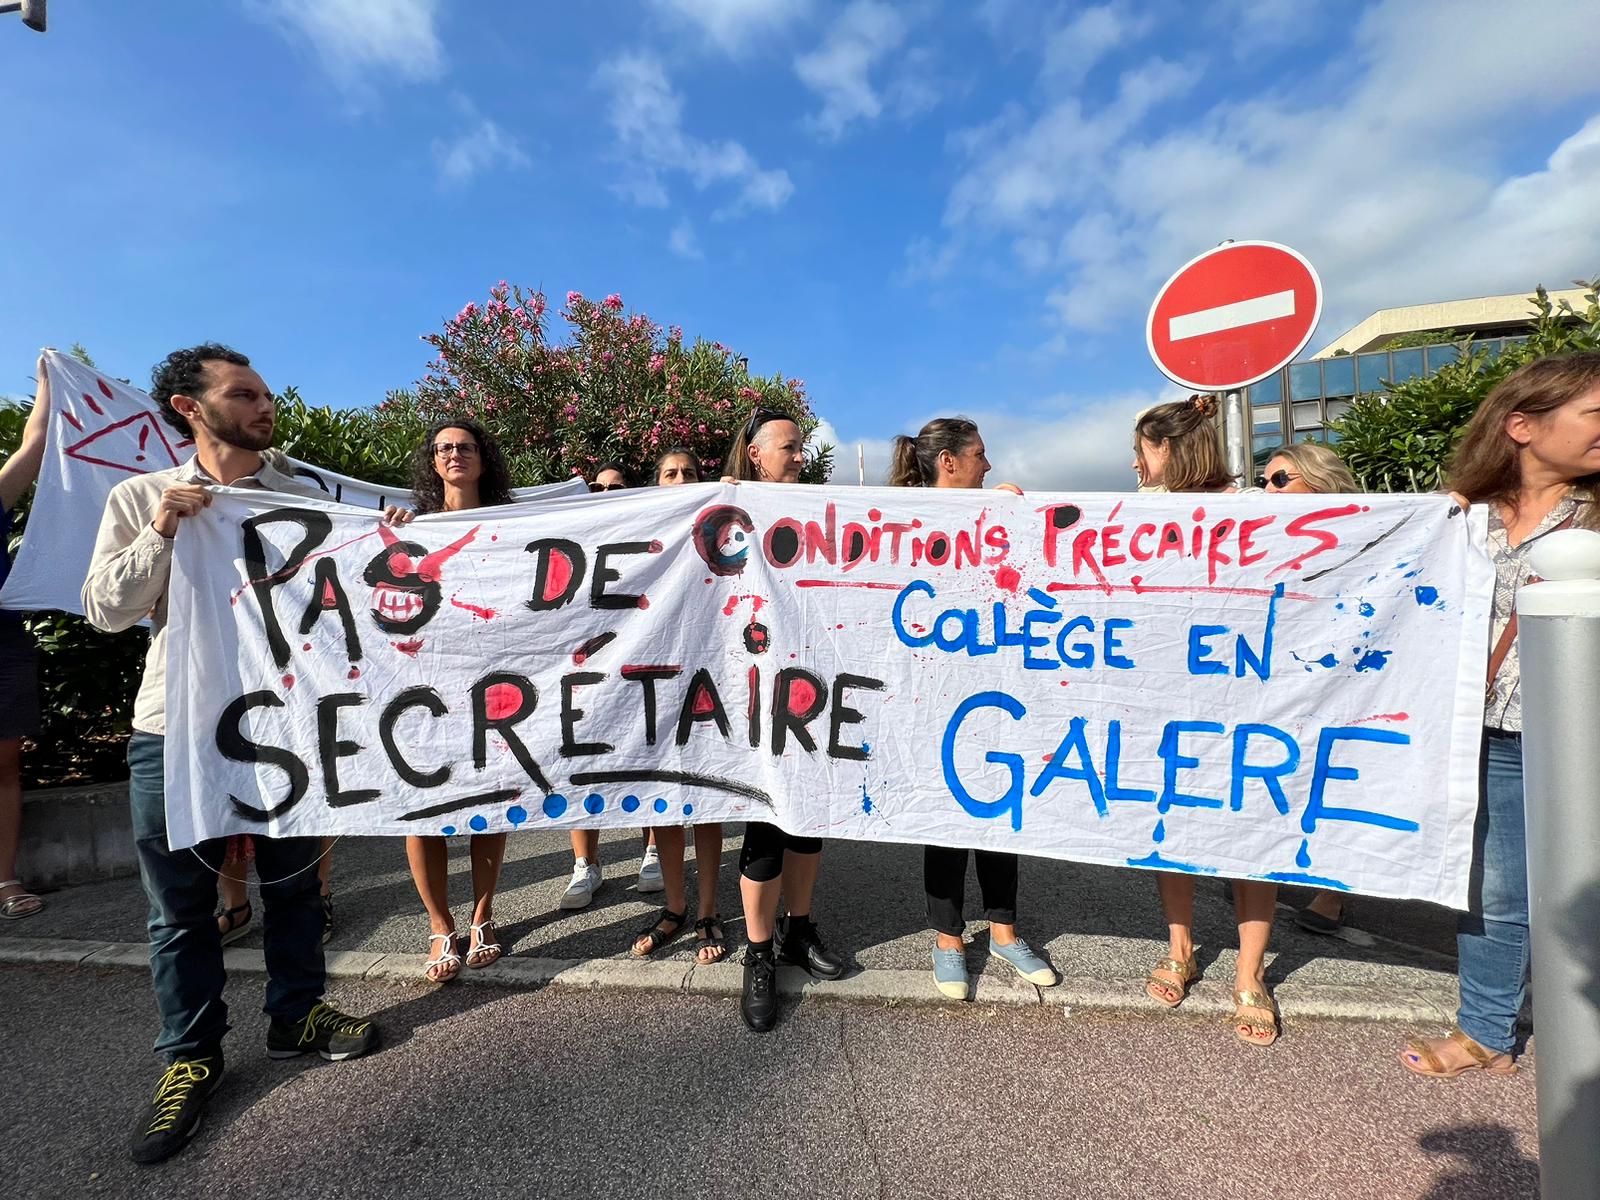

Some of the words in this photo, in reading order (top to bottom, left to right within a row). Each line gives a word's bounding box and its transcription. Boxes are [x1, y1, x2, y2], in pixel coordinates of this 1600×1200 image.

[241, 507, 444, 670] PAS
[525, 538, 664, 611] DE
[1188, 582, 1285, 685] EN
[941, 691, 1419, 833] GALERE
